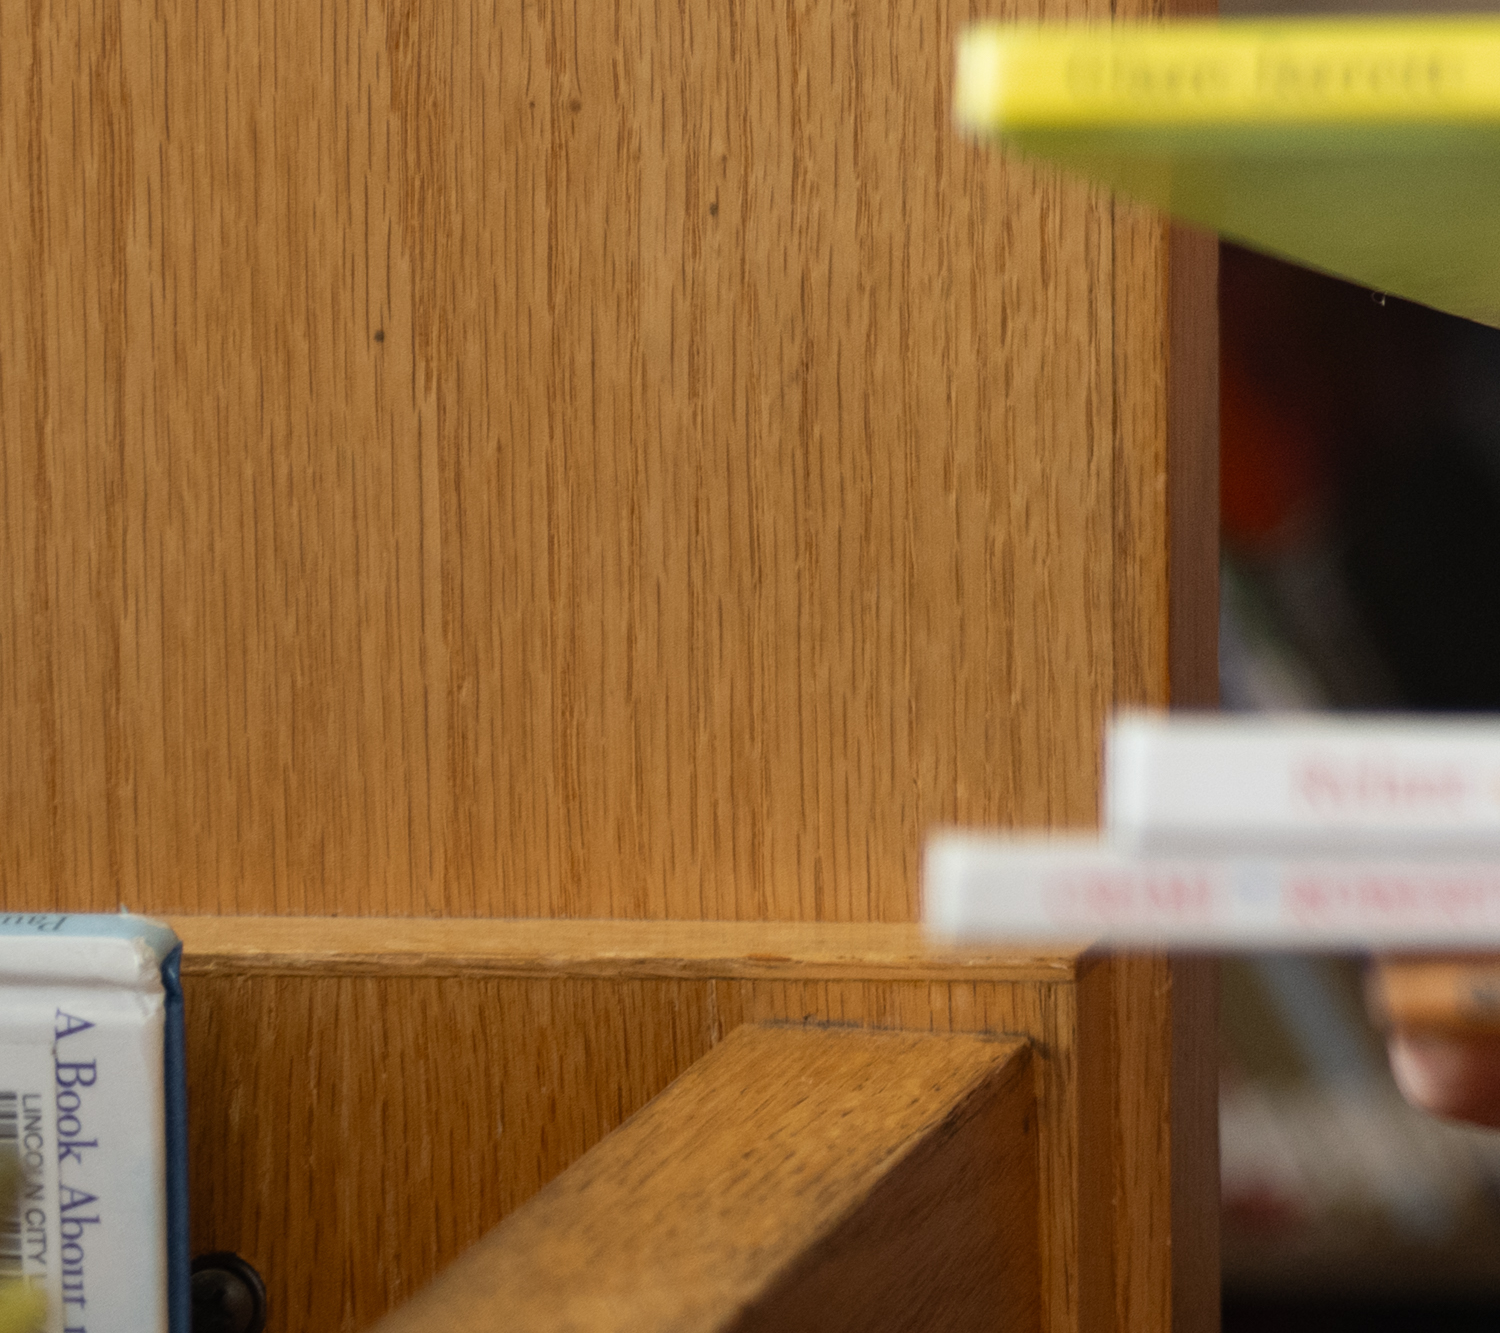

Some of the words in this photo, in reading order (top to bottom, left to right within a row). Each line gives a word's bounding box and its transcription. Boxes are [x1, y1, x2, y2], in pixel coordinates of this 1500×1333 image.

[55, 1008, 96, 1041] A
[22, 1093, 46, 1202] LINCON
[54, 1058, 98, 1165] Book
[25, 1208, 48, 1265] CITY
[58, 1183, 102, 1310] About
